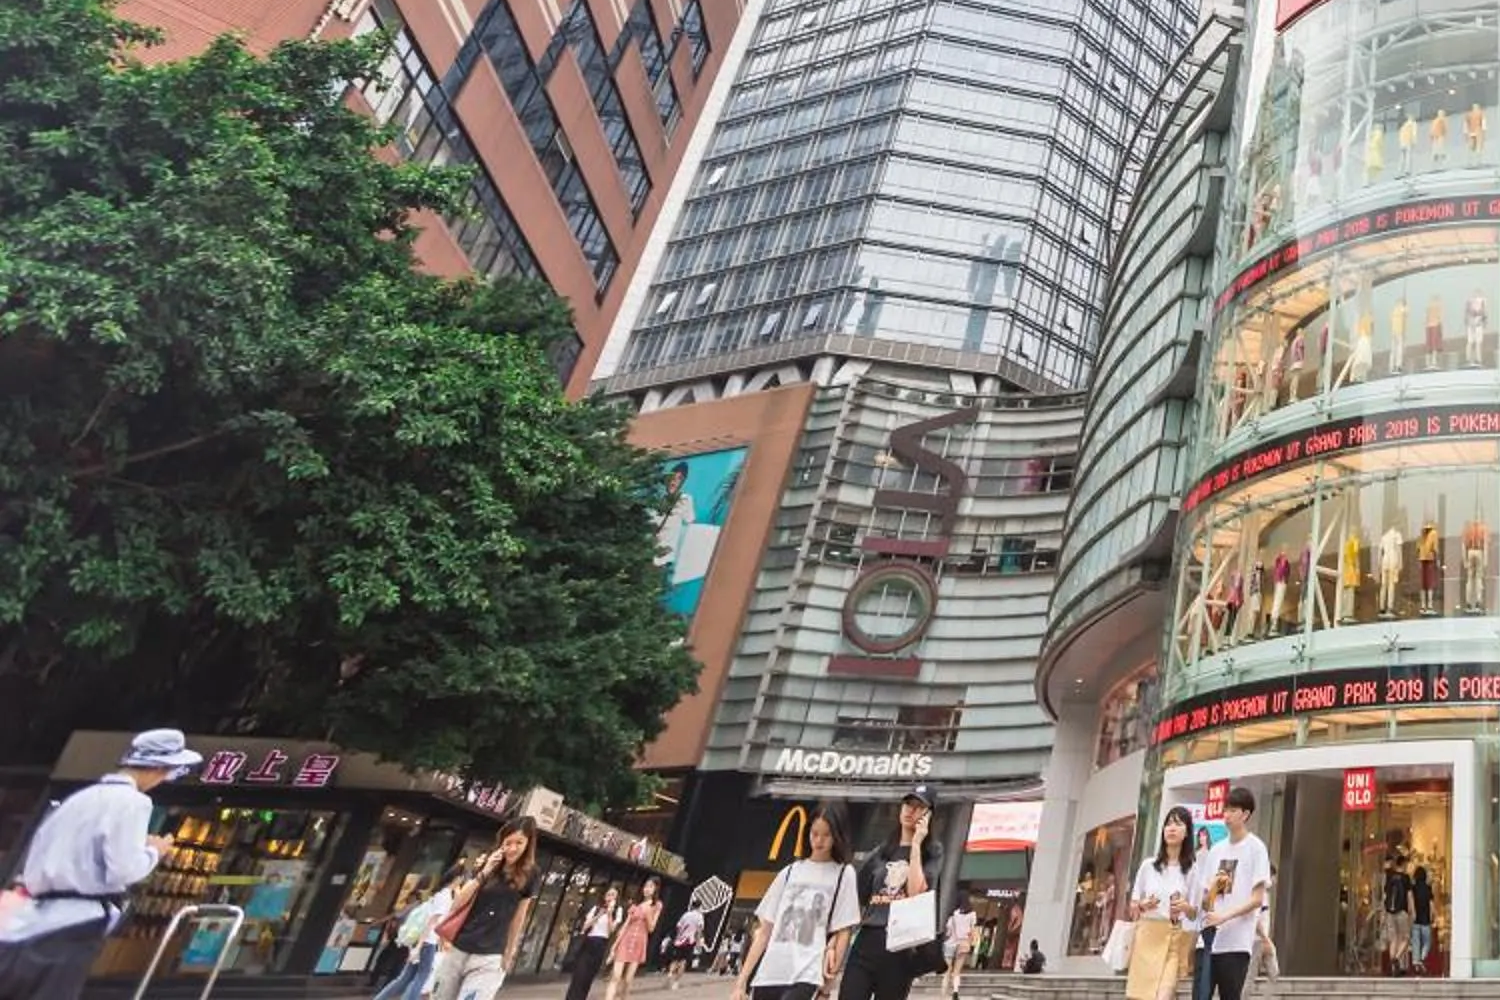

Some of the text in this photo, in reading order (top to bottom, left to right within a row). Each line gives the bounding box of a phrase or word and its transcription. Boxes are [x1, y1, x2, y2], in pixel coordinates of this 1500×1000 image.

[1394, 202, 1455, 225] POKEMON
[1462, 200, 1480, 216] UT
[1243, 446, 1284, 476] POKEMON
[1286, 441, 1301, 461] UT
[1305, 430, 1343, 456] GRAND
[1349, 422, 1377, 445] PRIX
[1384, 415, 1419, 439] 2019
[1427, 416, 1441, 434] IS
[1211, 703, 1220, 725] IS
[1222, 691, 1268, 721] POKEMON
[1272, 690, 1289, 713] UT
[1295, 684, 1337, 711] GRAND
[1343, 680, 1378, 705] PRIX
[1386, 678, 1423, 703] 2019
[1433, 678, 1449, 699] IS
[775, 748, 933, 776] McDonald's
[1209, 783, 1225, 801] UNI
[1346, 773, 1370, 789] UNI
[1345, 789, 1371, 804] QLO
